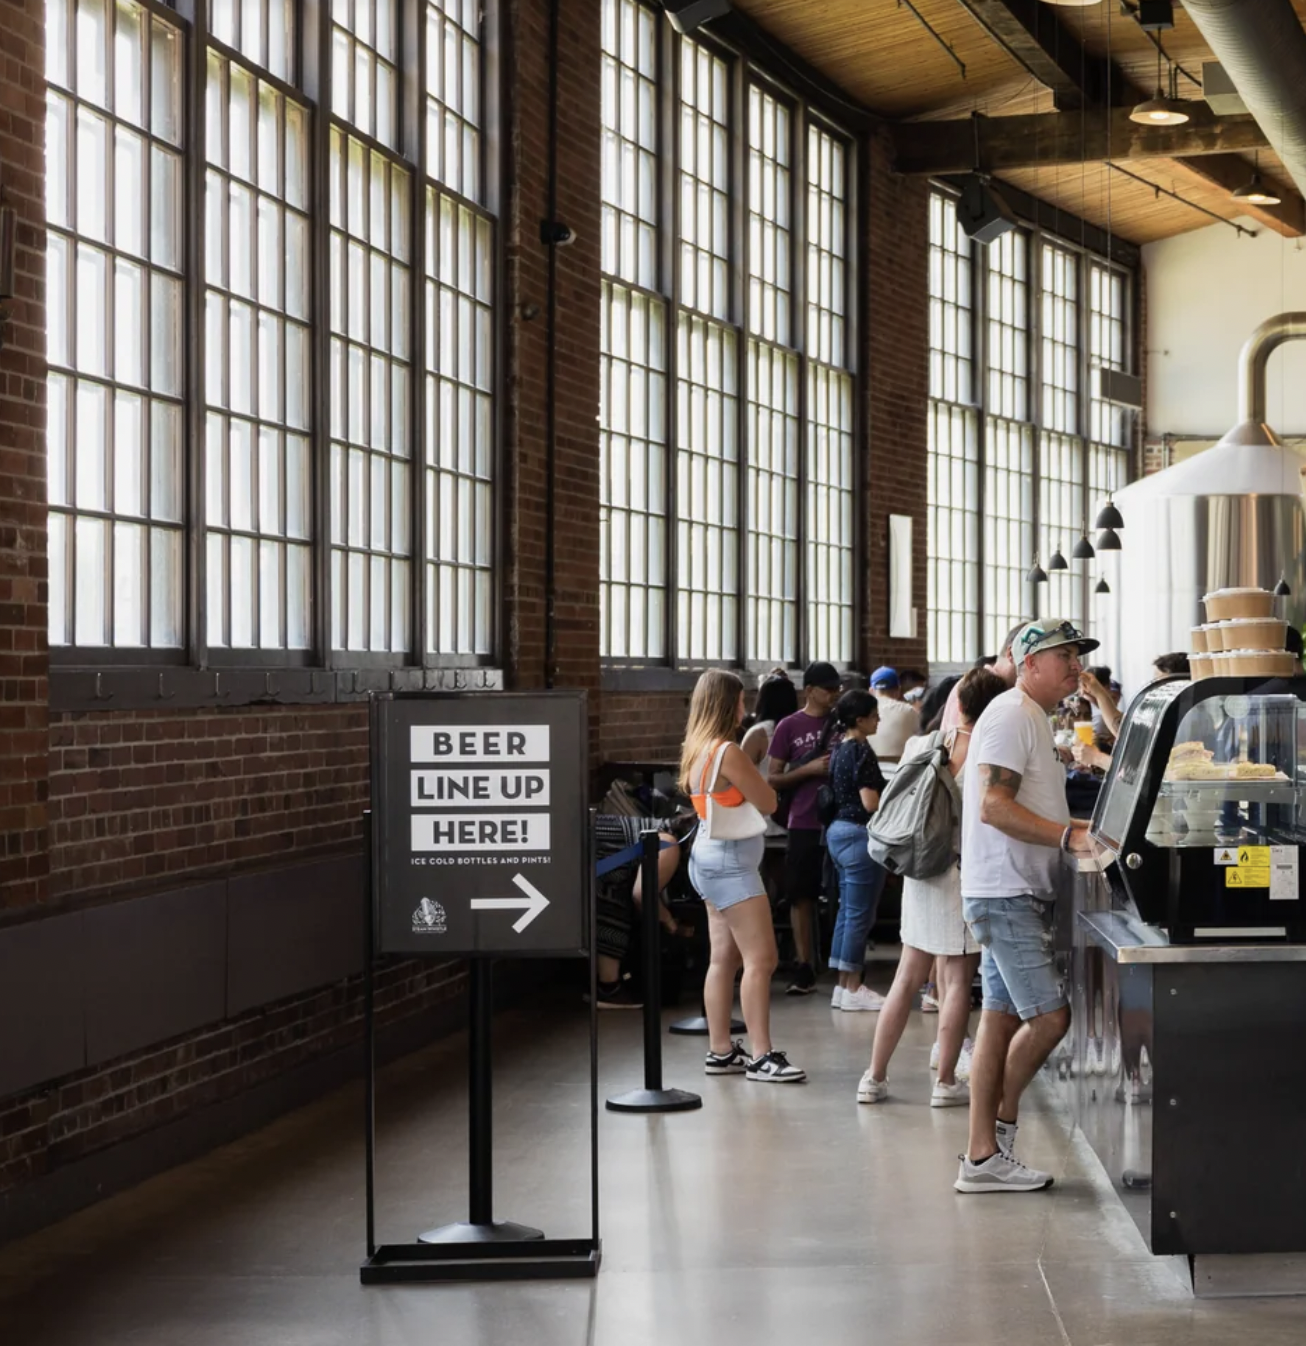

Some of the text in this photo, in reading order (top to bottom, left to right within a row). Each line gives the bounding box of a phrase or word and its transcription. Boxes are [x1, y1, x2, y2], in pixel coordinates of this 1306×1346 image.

[433, 732, 526, 756] BEER
[417, 775, 545, 800] LINE UP
[433, 820, 528, 844] HERE!
[411, 856, 551, 866] ICE COLD BOTTLES AND PINTS!
